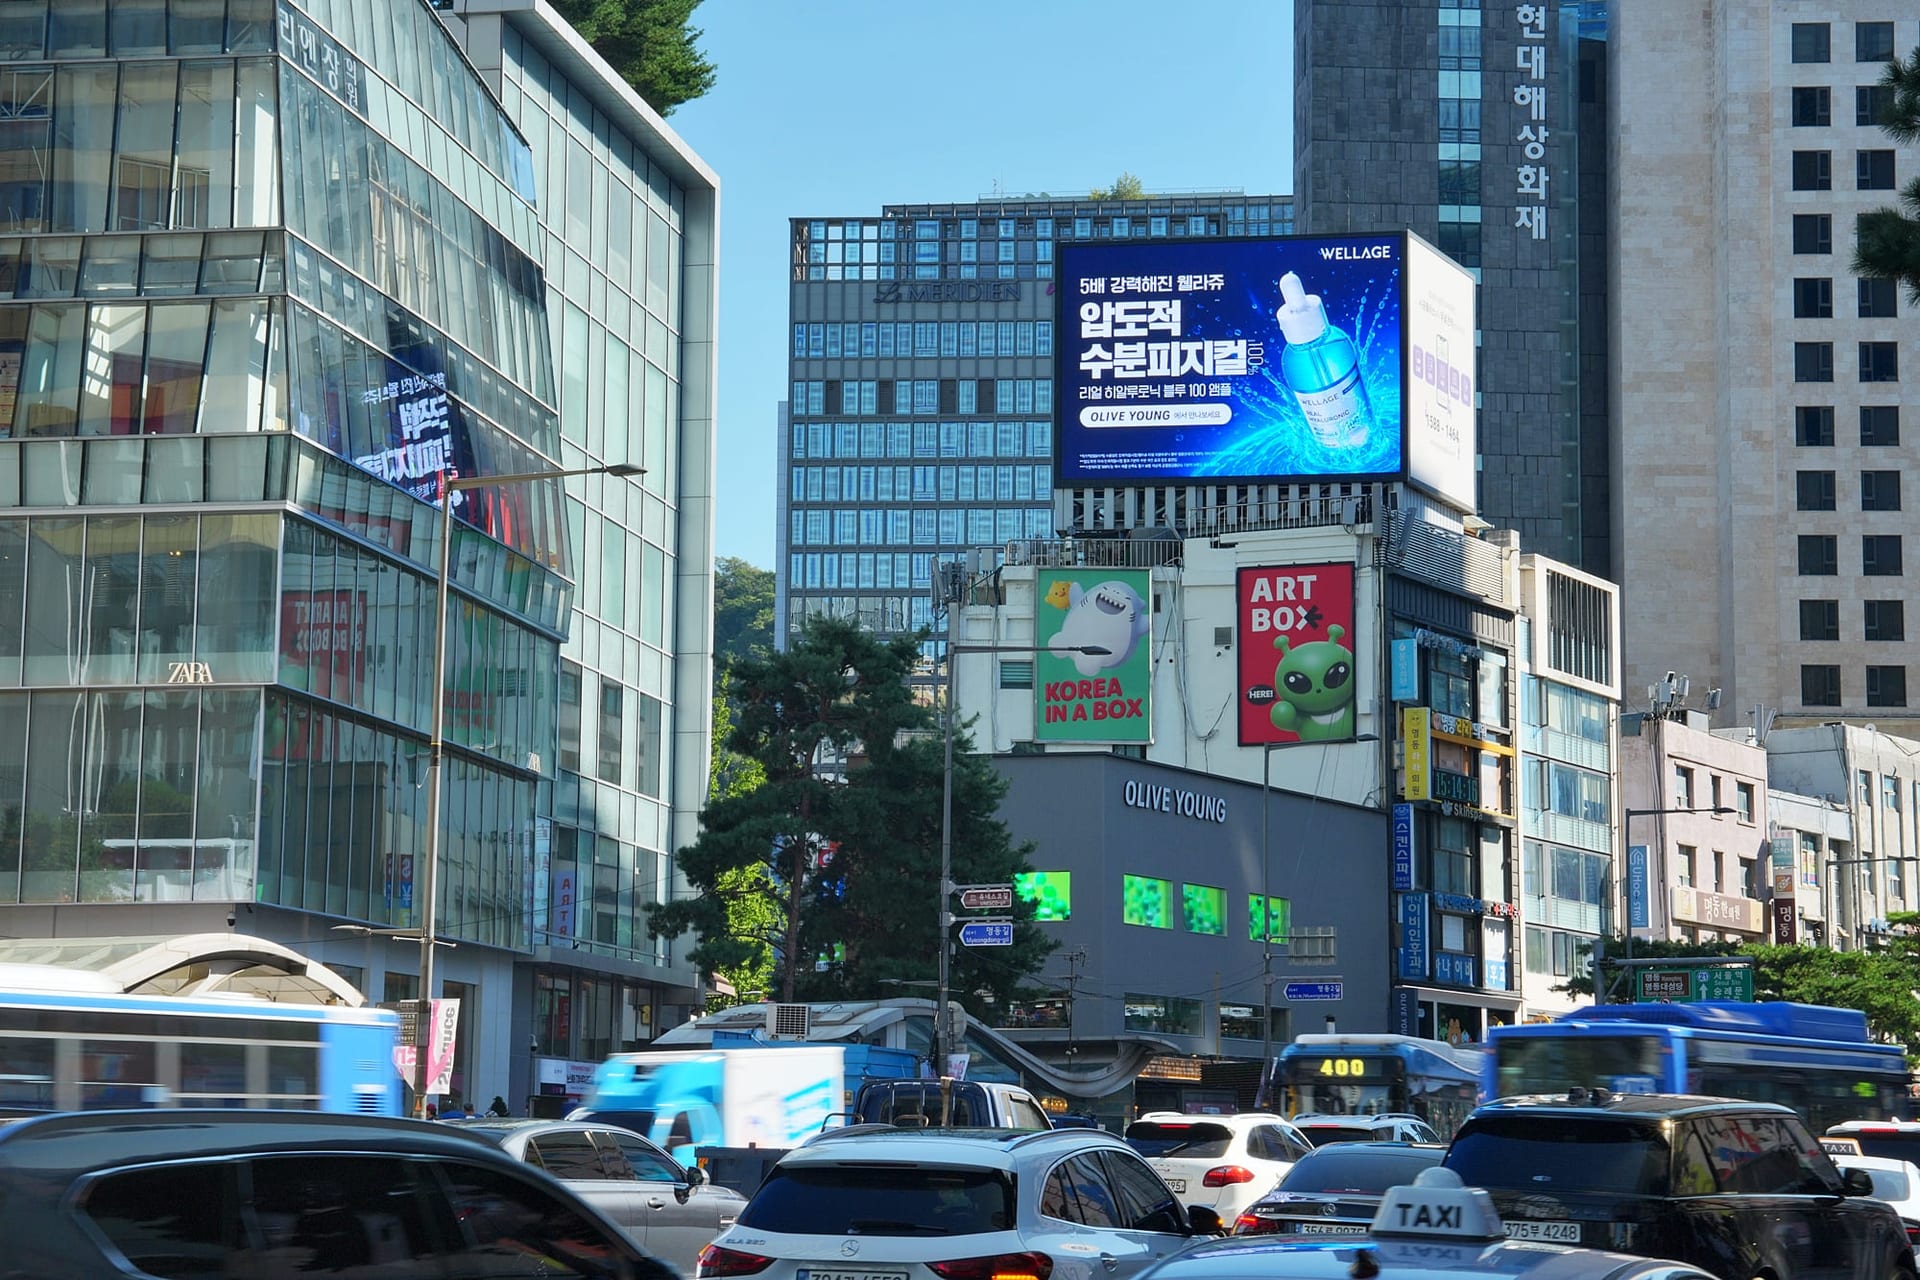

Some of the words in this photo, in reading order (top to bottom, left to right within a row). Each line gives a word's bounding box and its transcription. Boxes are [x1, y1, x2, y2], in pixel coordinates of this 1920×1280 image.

[280, 8, 338, 91] 리엔장
[1514, 4, 1549, 240] 현대해상화재
[1321, 245, 1391, 260] WELLAGE
[1110, 275, 1173, 294] 강력해진
[1177, 274, 1225, 291] 웰라쥬
[1079, 300, 1182, 338] 압도적
[1079, 339, 1248, 379] 수분피지컬
[1079, 385, 1102, 400] 리얼
[1104, 384, 1161, 399] 히알루로닉
[1163, 383, 1186, 398] 블루
[1189, 383, 1206, 397] 100
[1208, 382, 1232, 397] 앰플
[1090, 411, 1125, 422] OLIVE
[1129, 410, 1170, 421] YOUNG
[1250, 575, 1317, 602] ART
[1252, 605, 1318, 632] BOX
[168, 662, 213, 684] ZARA
[1045, 677, 1122, 702] KOREA
[1248, 689, 1274, 699] HERE!
[1045, 704, 1067, 723] IN
[1072, 702, 1087, 722] A
[1093, 698, 1143, 720] BOX
[1125, 780, 1171, 812] OLIVE
[1175, 789, 1226, 823] YOUNG
[1396, 822, 1409, 875] 스킨스파
[986, 926, 1009, 936] 명동길
[1408, 903, 1422, 968] 이비인후과
[1778, 905, 1793, 946] 명동
[1714, 971, 1743, 980] 서울역
[1713, 986, 1743, 996] 숭례문
[1320, 1059, 1364, 1076] 400
[1823, 1143, 1852, 1153] TAXI
[1396, 1203, 1462, 1229] TAXI
[1543, 1224, 1578, 1240] 4248
